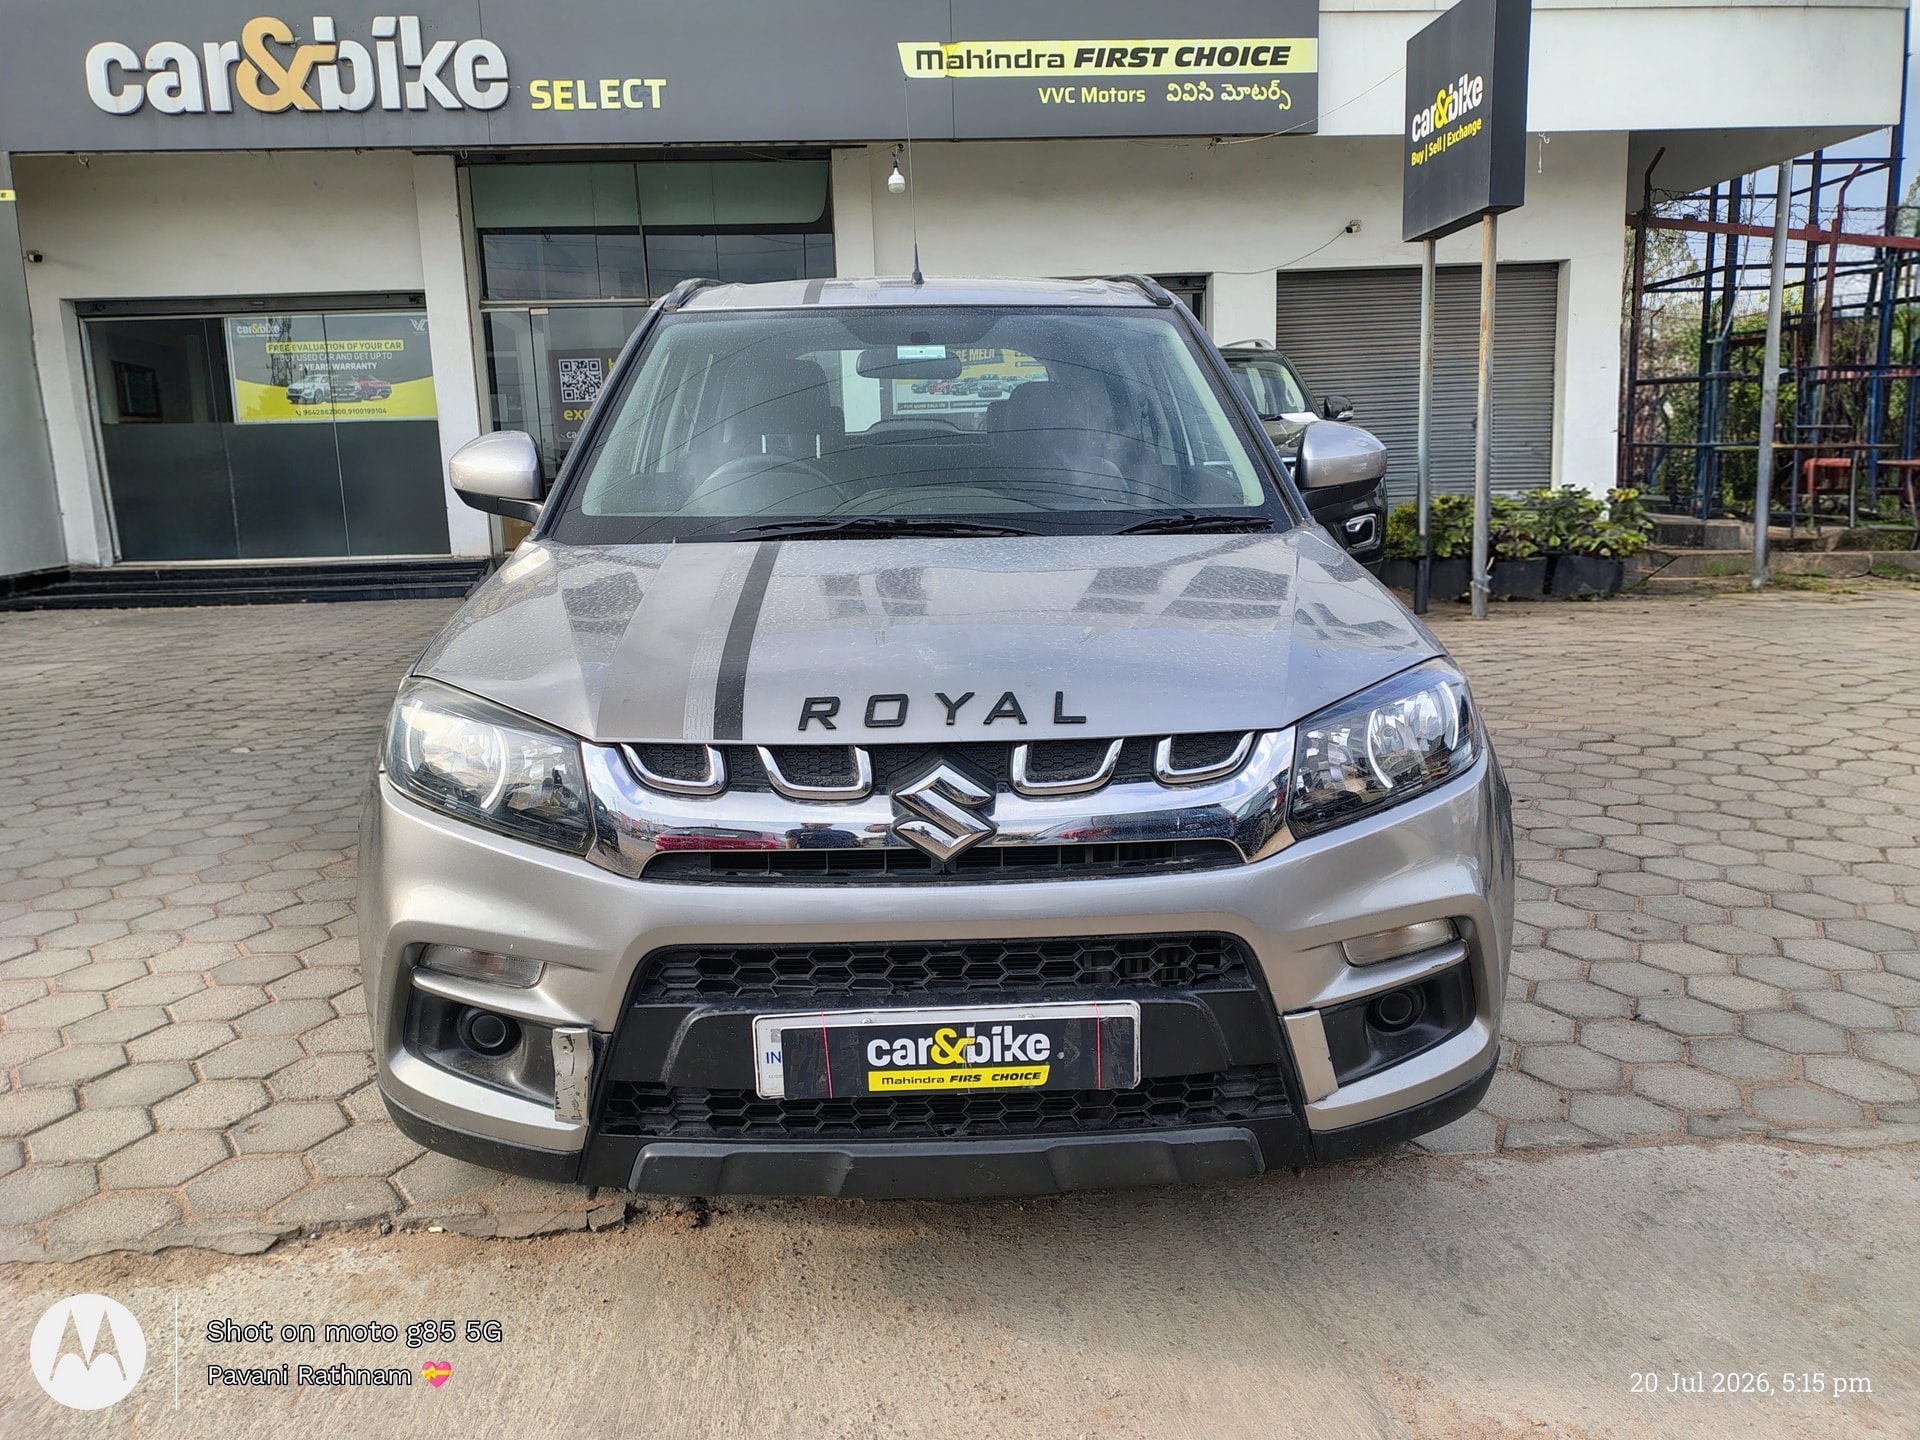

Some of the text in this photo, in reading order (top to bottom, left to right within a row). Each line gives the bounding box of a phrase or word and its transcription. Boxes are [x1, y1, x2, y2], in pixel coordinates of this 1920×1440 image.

[85, 15, 510, 116] car&bike
[915, 46, 1292, 71] Mahindra FIRST CHOICE
[529, 78, 667, 111] SELECT
[1038, 85, 1146, 104] VVC Motors
[1166, 81, 1214, 101] వివిసి
[1411, 73, 1483, 143] car&bike
[1411, 118, 1482, 166] Buy Sell Exchange
[268, 341, 402, 352] FREE EVALUATION OF YOUR CAR
[297, 353, 318, 361] USED
[335, 353, 353, 361] AND
[354, 352, 369, 360] GET
[370, 352, 381, 360] UP
[382, 352, 393, 360] TO
[299, 363, 305, 371] 2
[332, 361, 378, 370] WARRANTY
[798, 691, 1087, 731] ROYAL
[867, 1026, 1051, 1066] car&bike
[766, 1051, 782, 1064] IN
[881, 1077, 945, 1085] Mahindra
[991, 1072, 1042, 1082] CHOICE
